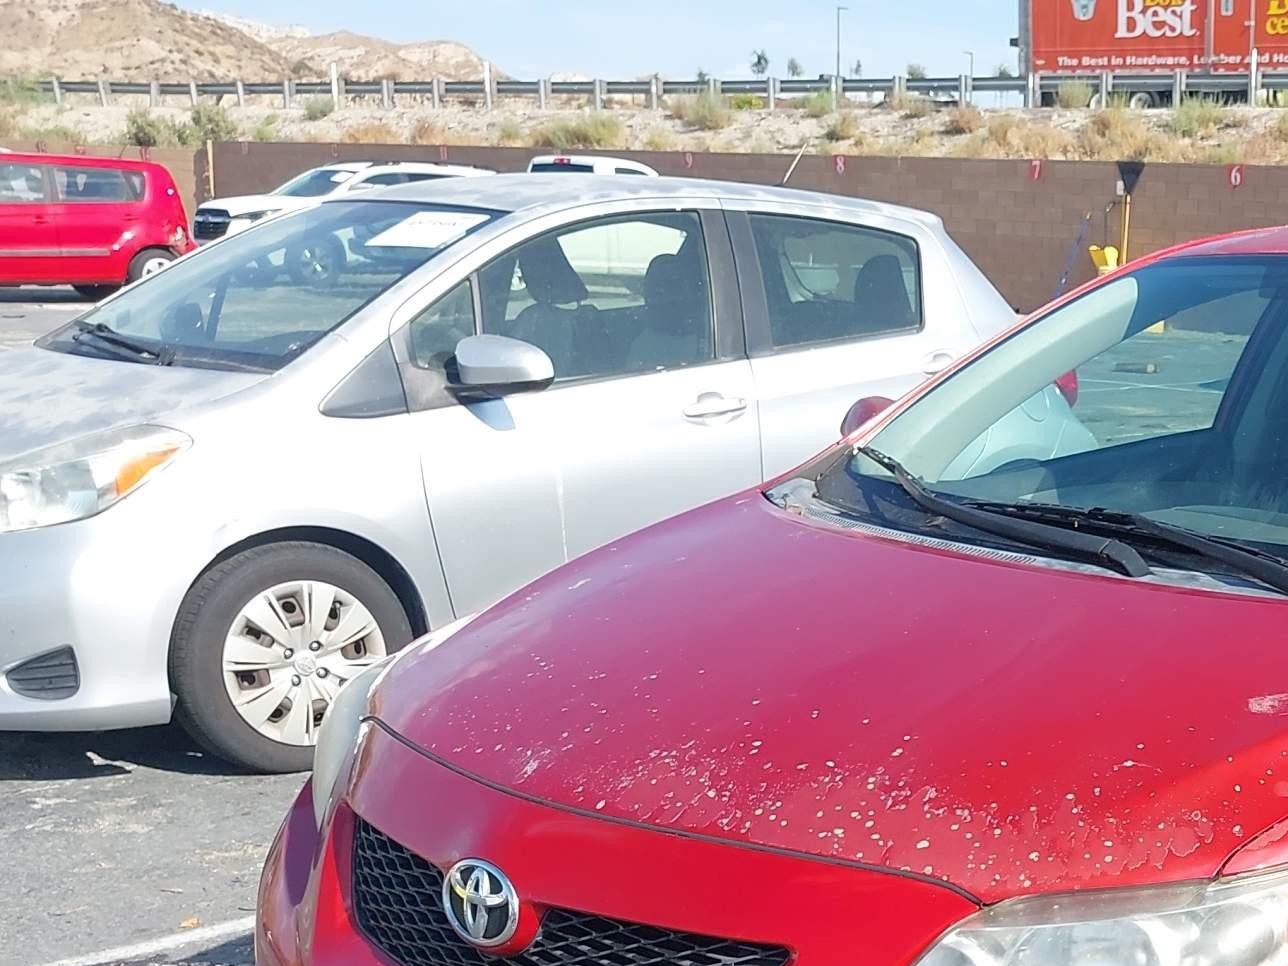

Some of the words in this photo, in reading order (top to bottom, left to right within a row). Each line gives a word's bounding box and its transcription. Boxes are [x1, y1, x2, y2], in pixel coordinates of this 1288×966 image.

[1114, 0, 1197, 38] Best
[1057, 56, 1079, 66] The
[1082, 56, 1109, 66] Best
[1126, 54, 1190, 66] Hardware,
[836, 155, 845, 174] 8
[1032, 160, 1041, 180] 7
[1230, 165, 1241, 186] 6
